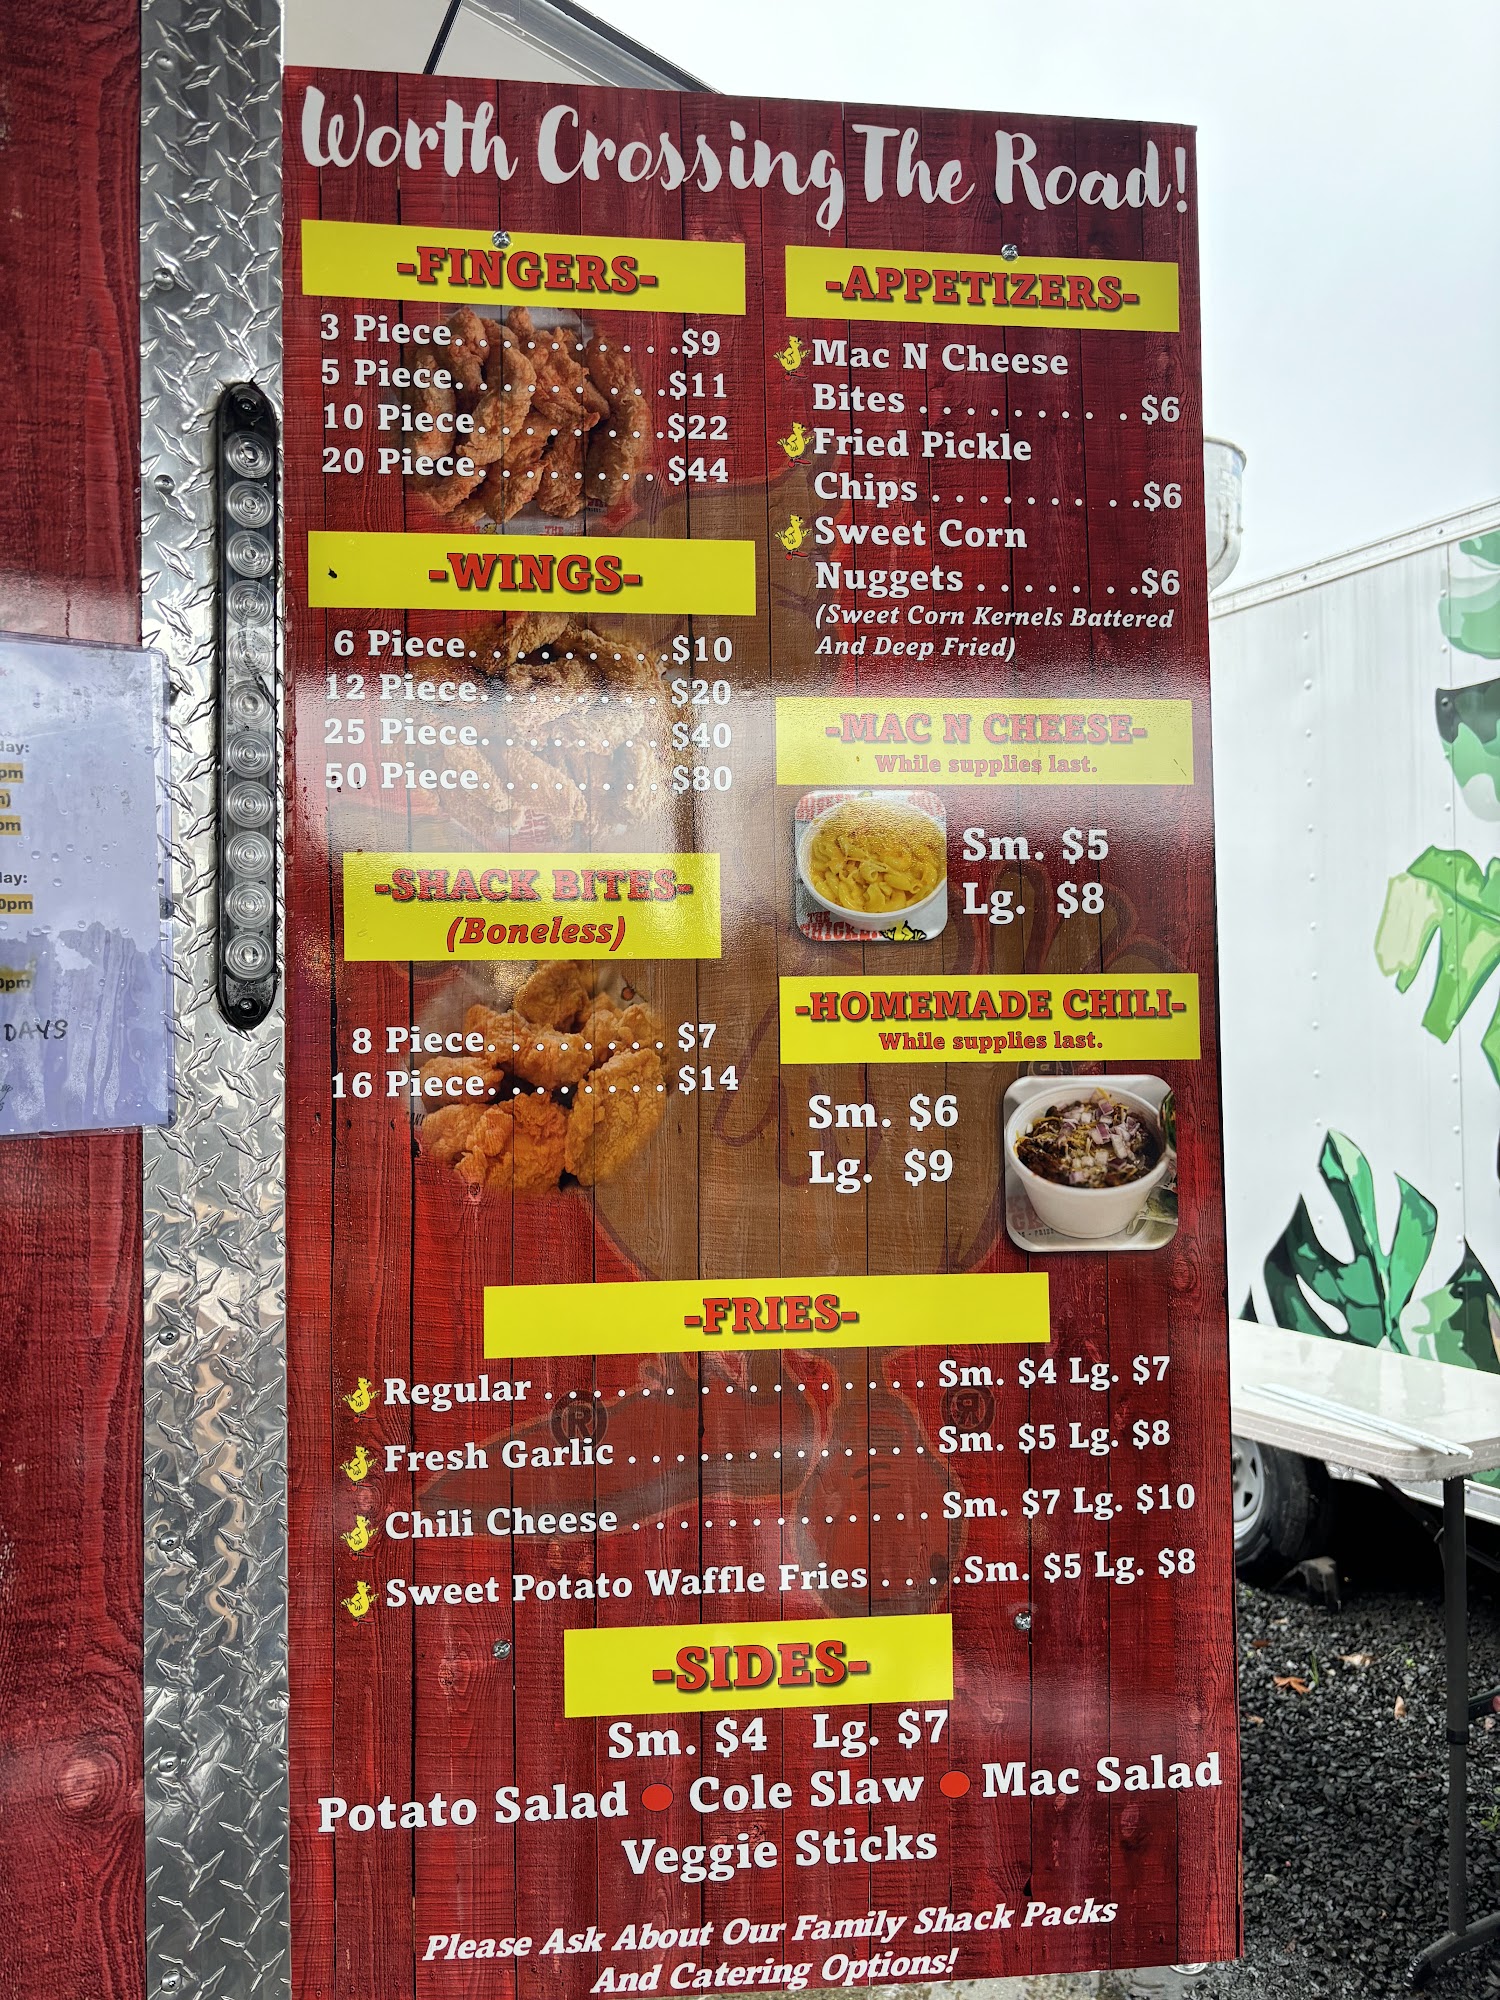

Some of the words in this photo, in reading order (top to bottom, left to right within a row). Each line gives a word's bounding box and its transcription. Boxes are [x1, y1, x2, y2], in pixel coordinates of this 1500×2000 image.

[301, 85, 518, 180] Worth
[537, 104, 844, 232] Crossing
[852, 123, 976, 205] The
[994, 128, 1188, 213] Road!
[320, 314, 339, 340] 3
[682, 329, 720, 358] $9
[813, 339, 889, 369] Mac
[903, 343, 927, 369] N
[941, 343, 1068, 375] Cheese
[321, 359, 339, 385] 5
[669, 371, 726, 400] $11
[324, 404, 364, 430] 10
[668, 414, 728, 442] $22
[813, 384, 904, 414] Bites
[1141, 395, 1180, 424] $6
[813, 428, 908, 457] Fried
[921, 431, 1032, 461] Pickle
[322, 448, 364, 473] 20
[668, 456, 728, 485] $44
[814, 472, 918, 508] Chips
[1143, 481, 1182, 510] $6
[815, 516, 926, 547] Sweet
[939, 520, 1027, 549] Corn
[815, 563, 963, 598] Nuggets
[1141, 568, 1180, 597] $6
[815, 604, 900, 628] (Sweet
[907, 605, 966, 626] Corn
[973, 606, 1063, 628] Kernels
[1069, 608, 1173, 628] Battered
[334, 631, 353, 656] 6
[672, 635, 732, 665] $10
[815, 636, 865, 657] And
[873, 636, 934, 660] Deep
[941, 637, 1016, 660] Fried)
[325, 674, 365, 700] 12
[671, 678, 731, 708] $20
[324, 719, 365, 744] 25
[672, 722, 732, 751] $40
[943, 713, 970, 744] N
[325, 762, 367, 789] 50
[672, 765, 732, 794] $80
[875, 755, 940, 773] While
[949, 754, 1042, 777] supplies
[1049, 755, 1098, 773] last.
[962, 828, 1044, 861] Sm.
[1062, 827, 1109, 865] $5
[962, 882, 1025, 925] Lg.
[1057, 881, 1104, 918] $8
[446, 916, 625, 952] (Boneless)
[4, 1019, 69, 1042] DAYS
[352, 1028, 372, 1054] 8
[678, 1022, 716, 1051] $7
[879, 1033, 945, 1051] While
[953, 1031, 1047, 1053] supplies
[1054, 1030, 1102, 1049] last.
[332, 1073, 373, 1099] 16
[678, 1065, 739, 1094] $14
[808, 1094, 892, 1129] Sm.
[909, 1093, 958, 1132] $6
[808, 1150, 872, 1194] Lg.
[904, 1148, 953, 1186] $9
[384, 1374, 531, 1412] Regular
[938, 1359, 1004, 1387] Sm.
[1018, 1357, 1056, 1386] $4
[1069, 1357, 1119, 1390] Lg.
[1132, 1354, 1170, 1383] $7
[384, 1444, 488, 1473] Fresh
[502, 1438, 614, 1469] Garlic
[938, 1425, 1004, 1453] Sm.
[1018, 1423, 1055, 1452] $5
[1069, 1422, 1119, 1456] Lg.
[1132, 1420, 1170, 1448] $8
[385, 1509, 473, 1540] Chili
[487, 1507, 618, 1535] Cheese
[942, 1491, 1007, 1519] Sm.
[1022, 1489, 1060, 1517] $7
[1073, 1486, 1123, 1520] Lg.
[1136, 1484, 1195, 1513] $10
[386, 1576, 499, 1607] Sweet
[513, 1573, 632, 1601] Potato
[645, 1566, 765, 1597] Waffle
[779, 1562, 867, 1591] Fries
[964, 1555, 1030, 1583] Sm.
[1043, 1553, 1081, 1582] $5
[1094, 1551, 1144, 1585] Lg.
[1158, 1549, 1195, 1577] $8
[608, 1721, 696, 1759] Sm.
[715, 1717, 766, 1757] $4
[813, 1713, 879, 1758] Lg.
[898, 1709, 947, 1749] $7
[318, 1793, 477, 1832] Potato
[495, 1781, 628, 1823] Salad
[690, 1773, 793, 1813] Cole
[810, 1769, 924, 1807] Slaw
[982, 1762, 1079, 1798] Mac
[1097, 1751, 1222, 1793] Salad
[622, 1832, 778, 1884] Veggie
[796, 1826, 937, 1866] Sticks
[422, 1933, 532, 1961] Please
[539, 1926, 607, 1955] Ask
[613, 1921, 714, 1952] About
[723, 1916, 785, 1947] Our
[791, 1910, 907, 1943] Family
[913, 1904, 1013, 1935] Shack
[1021, 1898, 1118, 1928] Packs
[590, 1965, 660, 1994] And
[670, 1951, 810, 1992] Catering
[821, 1948, 959, 1986] Options!
